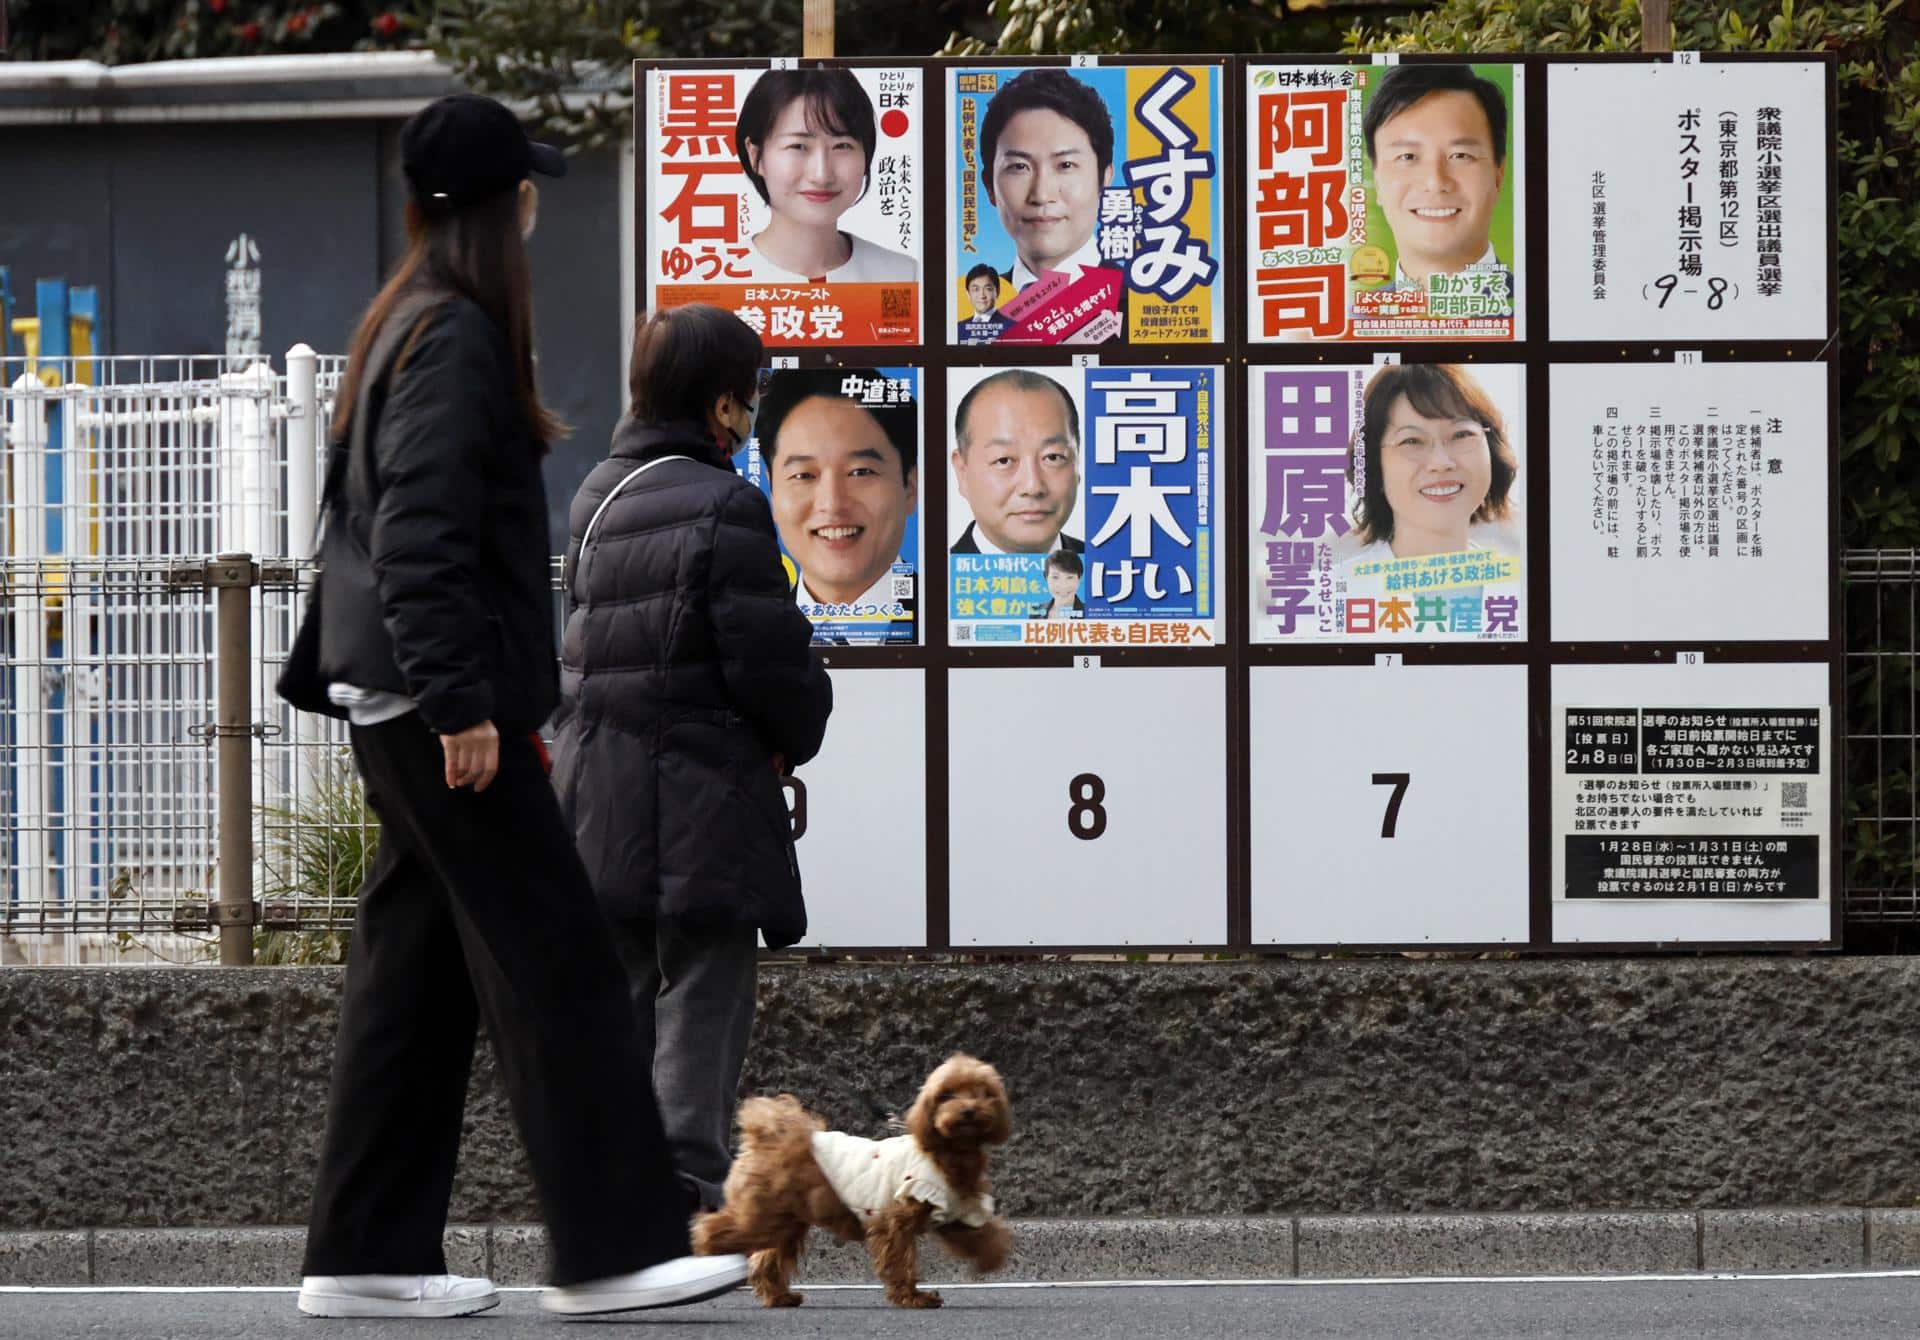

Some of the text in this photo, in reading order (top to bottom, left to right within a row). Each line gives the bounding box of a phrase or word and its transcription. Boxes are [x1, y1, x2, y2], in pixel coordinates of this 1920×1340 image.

[780, 60, 786, 70] 3
[1080, 56, 1086, 67] 2
[1680, 54, 1691, 64] 12
[880, 72, 904, 81] ひとり
[880, 82, 914, 91] ひとりが
[879, 94, 909, 108] 日本
[660, 75, 744, 244] 黒石
[878, 156, 897, 216] 政治を
[1130, 73, 1211, 296] くすみ
[1678, 108, 1702, 276] ポスター掲示場
[1719, 110, 1739, 248] （東京都第12区）
[740, 193, 750, 234] くろいし
[898, 155, 912, 249] 未来へとつなぐ
[1256, 89, 1348, 337] 阿部司
[1351, 188, 1366, 244] 3児の父
[1756, 107, 1782, 297] 衆議院小選挙区選出議員選挙
[1100, 189, 1135, 260] 勇樹
[1134, 203, 1143, 233] ゆうき
[1592, 171, 1606, 300] 北区選挙管理委員会
[661, 246, 752, 280] ゆうこ
[745, 288, 830, 301] 日本人ファースト
[1430, 273, 1509, 293] 動かすぞ、
[733, 305, 843, 339] 参政党
[1140, 316, 1200, 327] 投資銀行15年
[1143, 305, 1198, 315] 現役子育て中
[1133, 327, 1208, 338] スタートアップ経営
[782, 359, 788, 369] 6
[1082, 357, 1088, 367] 5
[1384, 356, 1390, 366] 4
[1682, 354, 1693, 364] 11
[841, 374, 886, 403] 中道
[886, 378, 911, 390] 改革
[886, 390, 912, 402] 連合
[1091, 373, 1192, 558] 高木
[1621, 424, 1633, 488] せられます。
[1664, 424, 1676, 500] 用できません。
[1722, 424, 1734, 511] はってください。
[1592, 424, 1605, 535] 車しないでください。
[1607, 424, 1619, 558] この掲示場の前には、駐
[1635, 424, 1648, 558] ターを破ったりすると罰
[1650, 424, 1662, 558] 掲示場を壊したり、ポス
[1679, 424, 1691, 558] このポスター掲示場を使
[1693, 424, 1705, 551] 選挙候補者以外の方は、
[1707, 424, 1719, 558] 衆議院小選挙区選出議員
[1736, 424, 1748, 557] 定された番号の区画に
[1750, 424, 1762, 558] 候補者は、ポスターを指
[955, 576, 1049, 594] 日本列島を、
[1091, 560, 1192, 603] けい
[1318, 543, 1332, 632] たはらせいこ
[1386, 562, 1511, 591] 給料あげる政治に
[956, 598, 1046, 616] 強く豊かに。
[1346, 595, 1518, 634] 日本共産党
[1025, 622, 1211, 643] 比例代表も自民党へ
[1083, 658, 1089, 668] 8
[1385, 656, 1392, 666] 7
[1684, 654, 1696, 664] 10
[1567, 715, 1636, 727] 第51回衆院選
[1664, 729, 1797, 742] 期日前投票開始日までに
[1646, 743, 1815, 756] 各ご家庭へ届かない見込みです
[1068, 773, 1107, 840] 8
[1371, 773, 1411, 838] 7
[1575, 806, 1763, 817] 北区の選挙人の要件を満たしていれば
[1576, 793, 1696, 804] をお持ちでない場合でも
[1575, 819, 1641, 831] 投票できます
[1603, 867, 1781, 879] 衆議院議員選挙と国民審査の両方が
[1620, 854, 1764, 866] 国民審査の投票はできません
